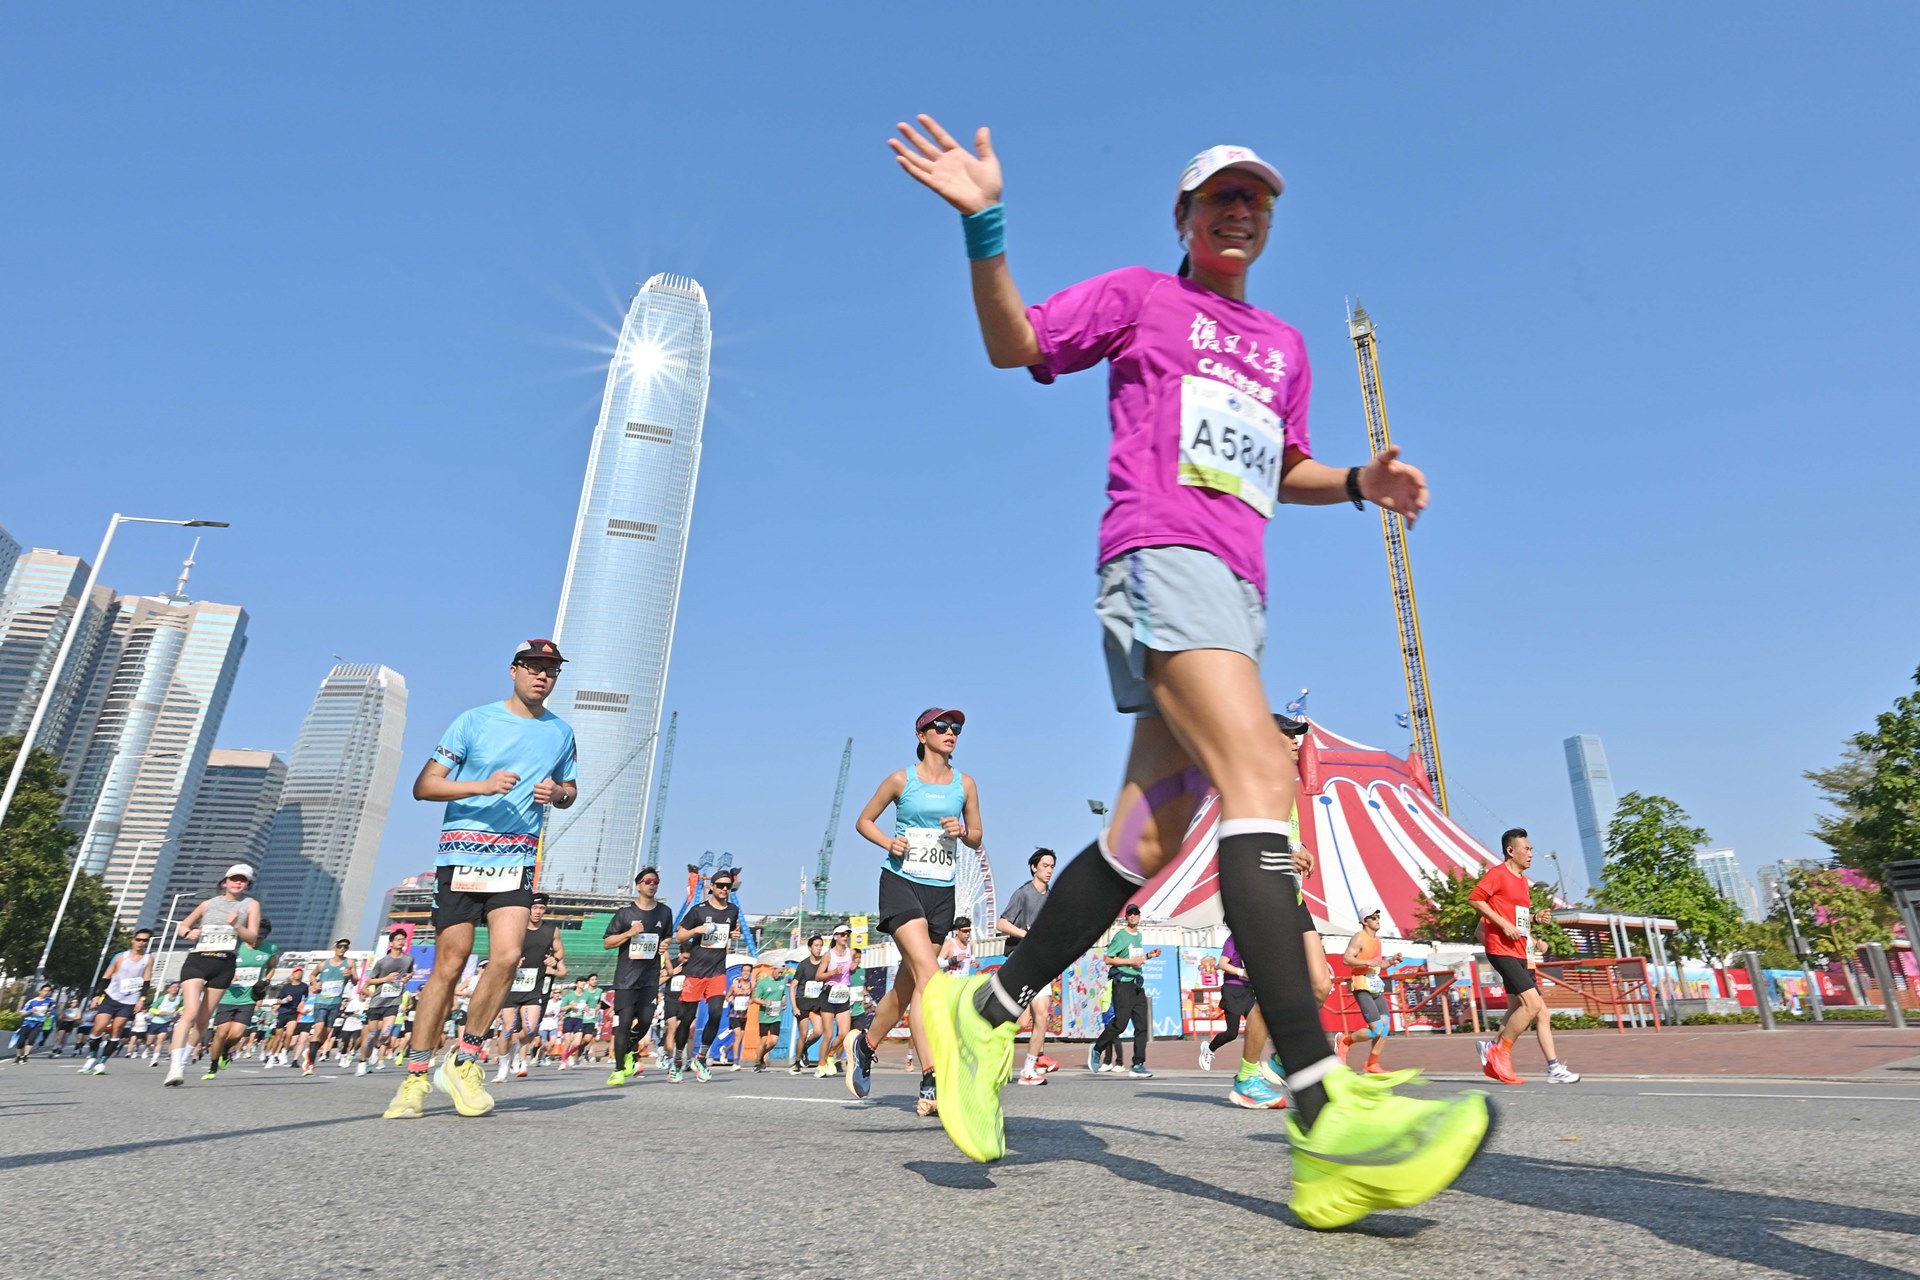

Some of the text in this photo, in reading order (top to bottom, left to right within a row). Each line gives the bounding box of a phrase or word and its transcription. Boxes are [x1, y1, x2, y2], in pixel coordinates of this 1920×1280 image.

[1191, 419, 1277, 487] A5841
[905, 846, 953, 866] E2805
[631, 942, 657, 952] D7908
